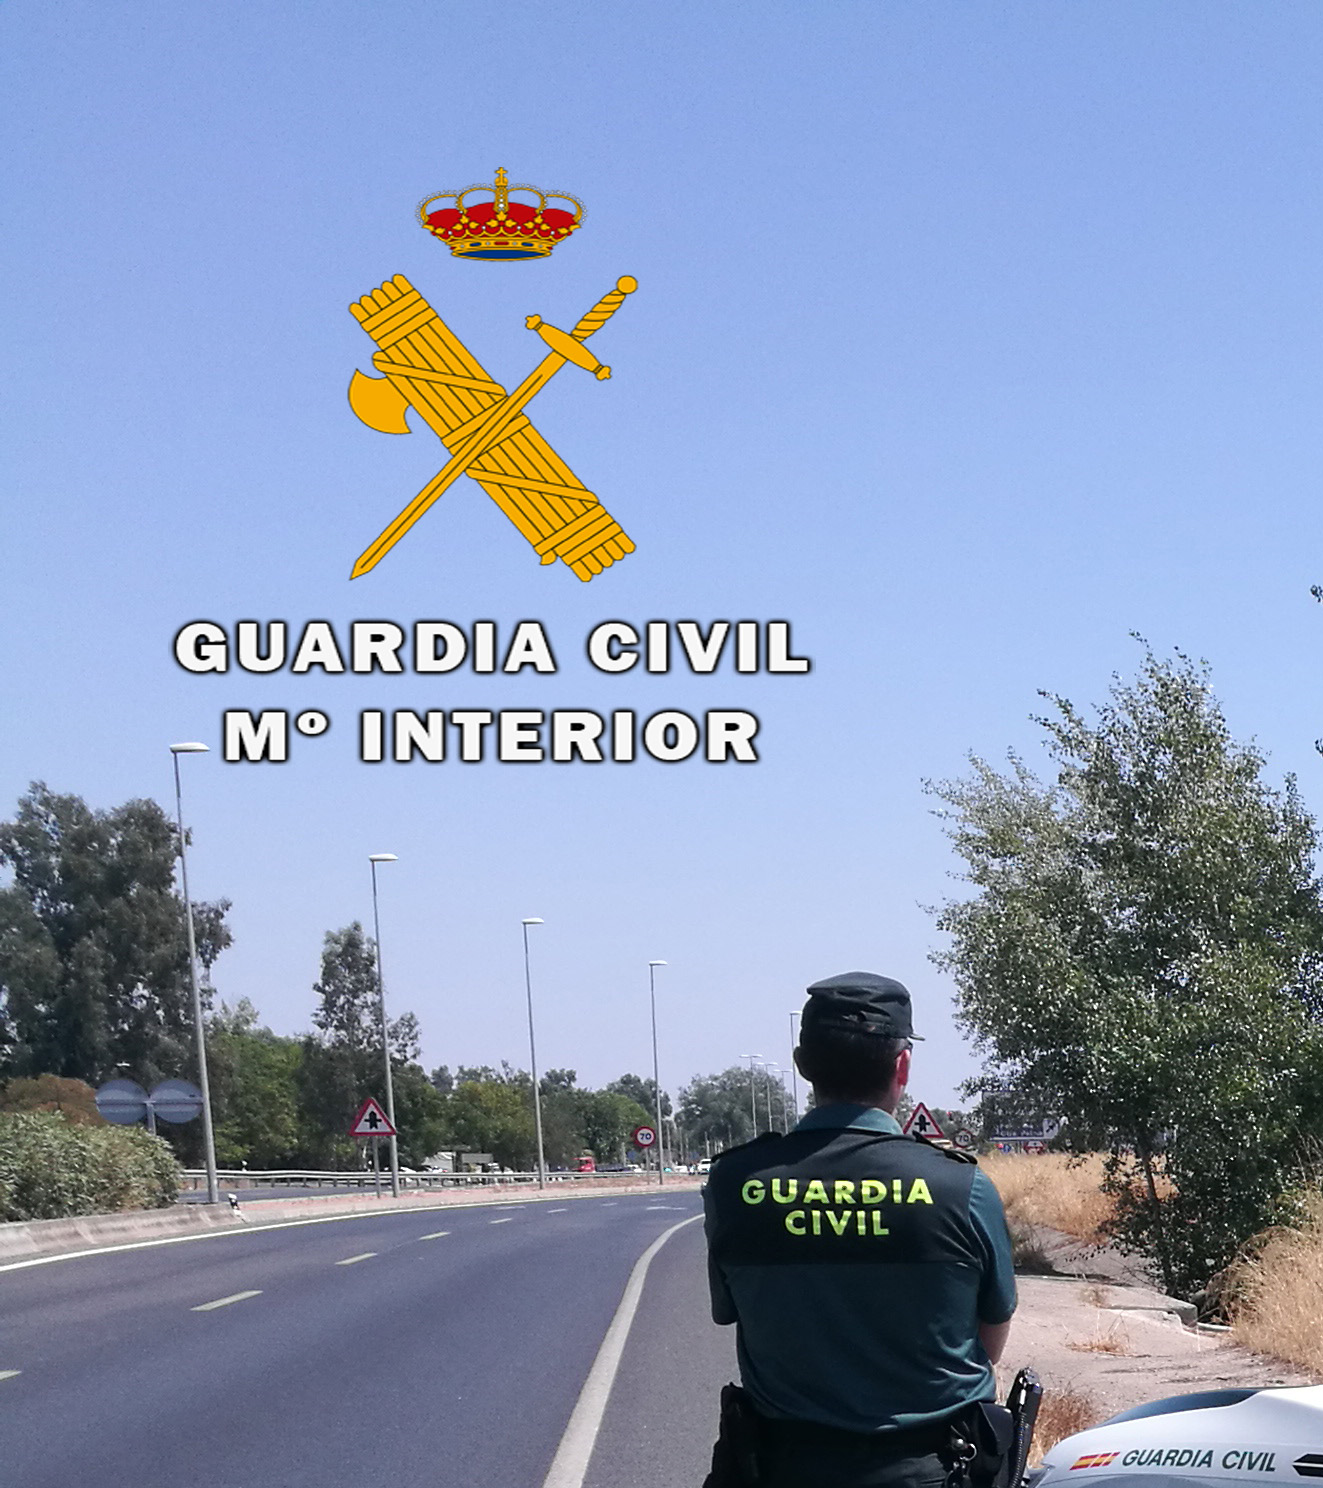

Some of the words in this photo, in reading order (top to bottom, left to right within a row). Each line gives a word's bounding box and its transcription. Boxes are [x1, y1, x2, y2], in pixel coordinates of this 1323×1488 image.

[741, 1178, 934, 1205] GUARDIA
[784, 1209, 890, 1237] CIVIL
[1121, 1449, 1213, 1469] GUARDIA
[1221, 1450, 1276, 1472] CIVIL
